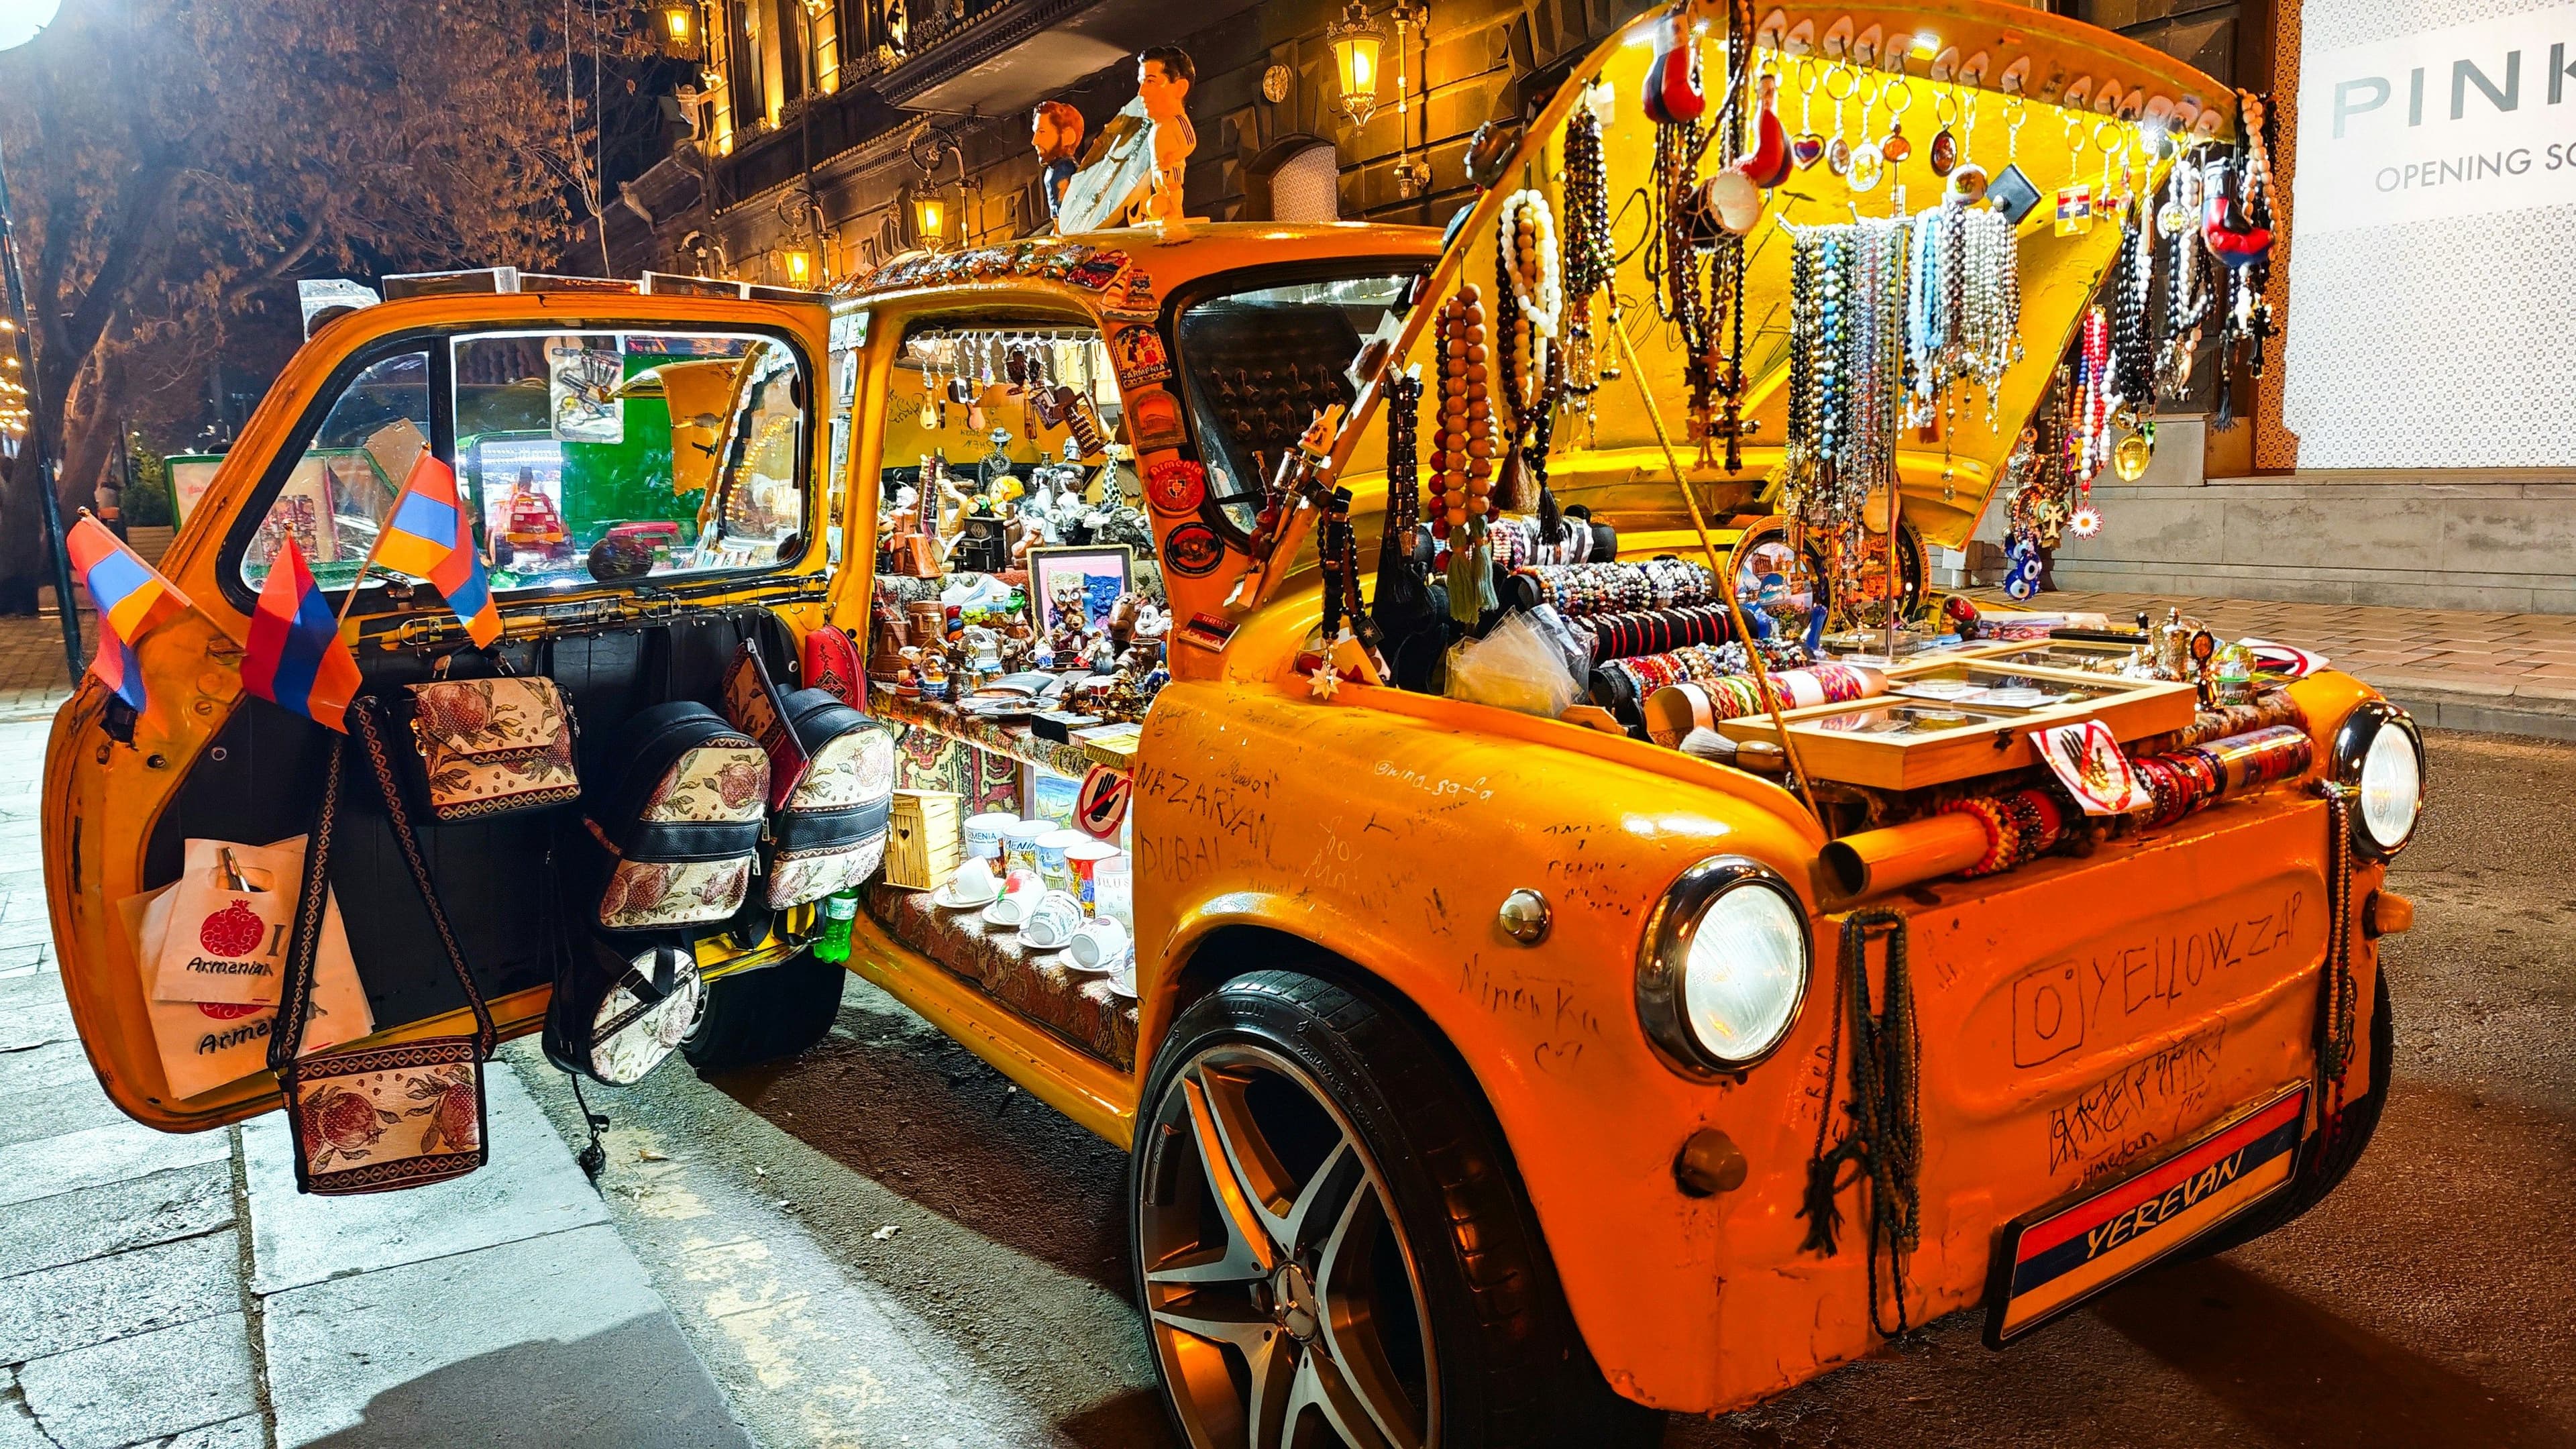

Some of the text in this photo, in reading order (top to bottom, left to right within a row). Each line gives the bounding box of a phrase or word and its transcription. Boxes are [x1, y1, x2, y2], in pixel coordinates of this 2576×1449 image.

[2375, 152, 2532, 192] OPENING
[1126, 364, 1166, 380] ARMENIA
[1135, 761, 1276, 859] NAZARYAN
[1139, 826, 1221, 883] DUBAI
[2086, 1148, 2244, 1260] YEREVAN
